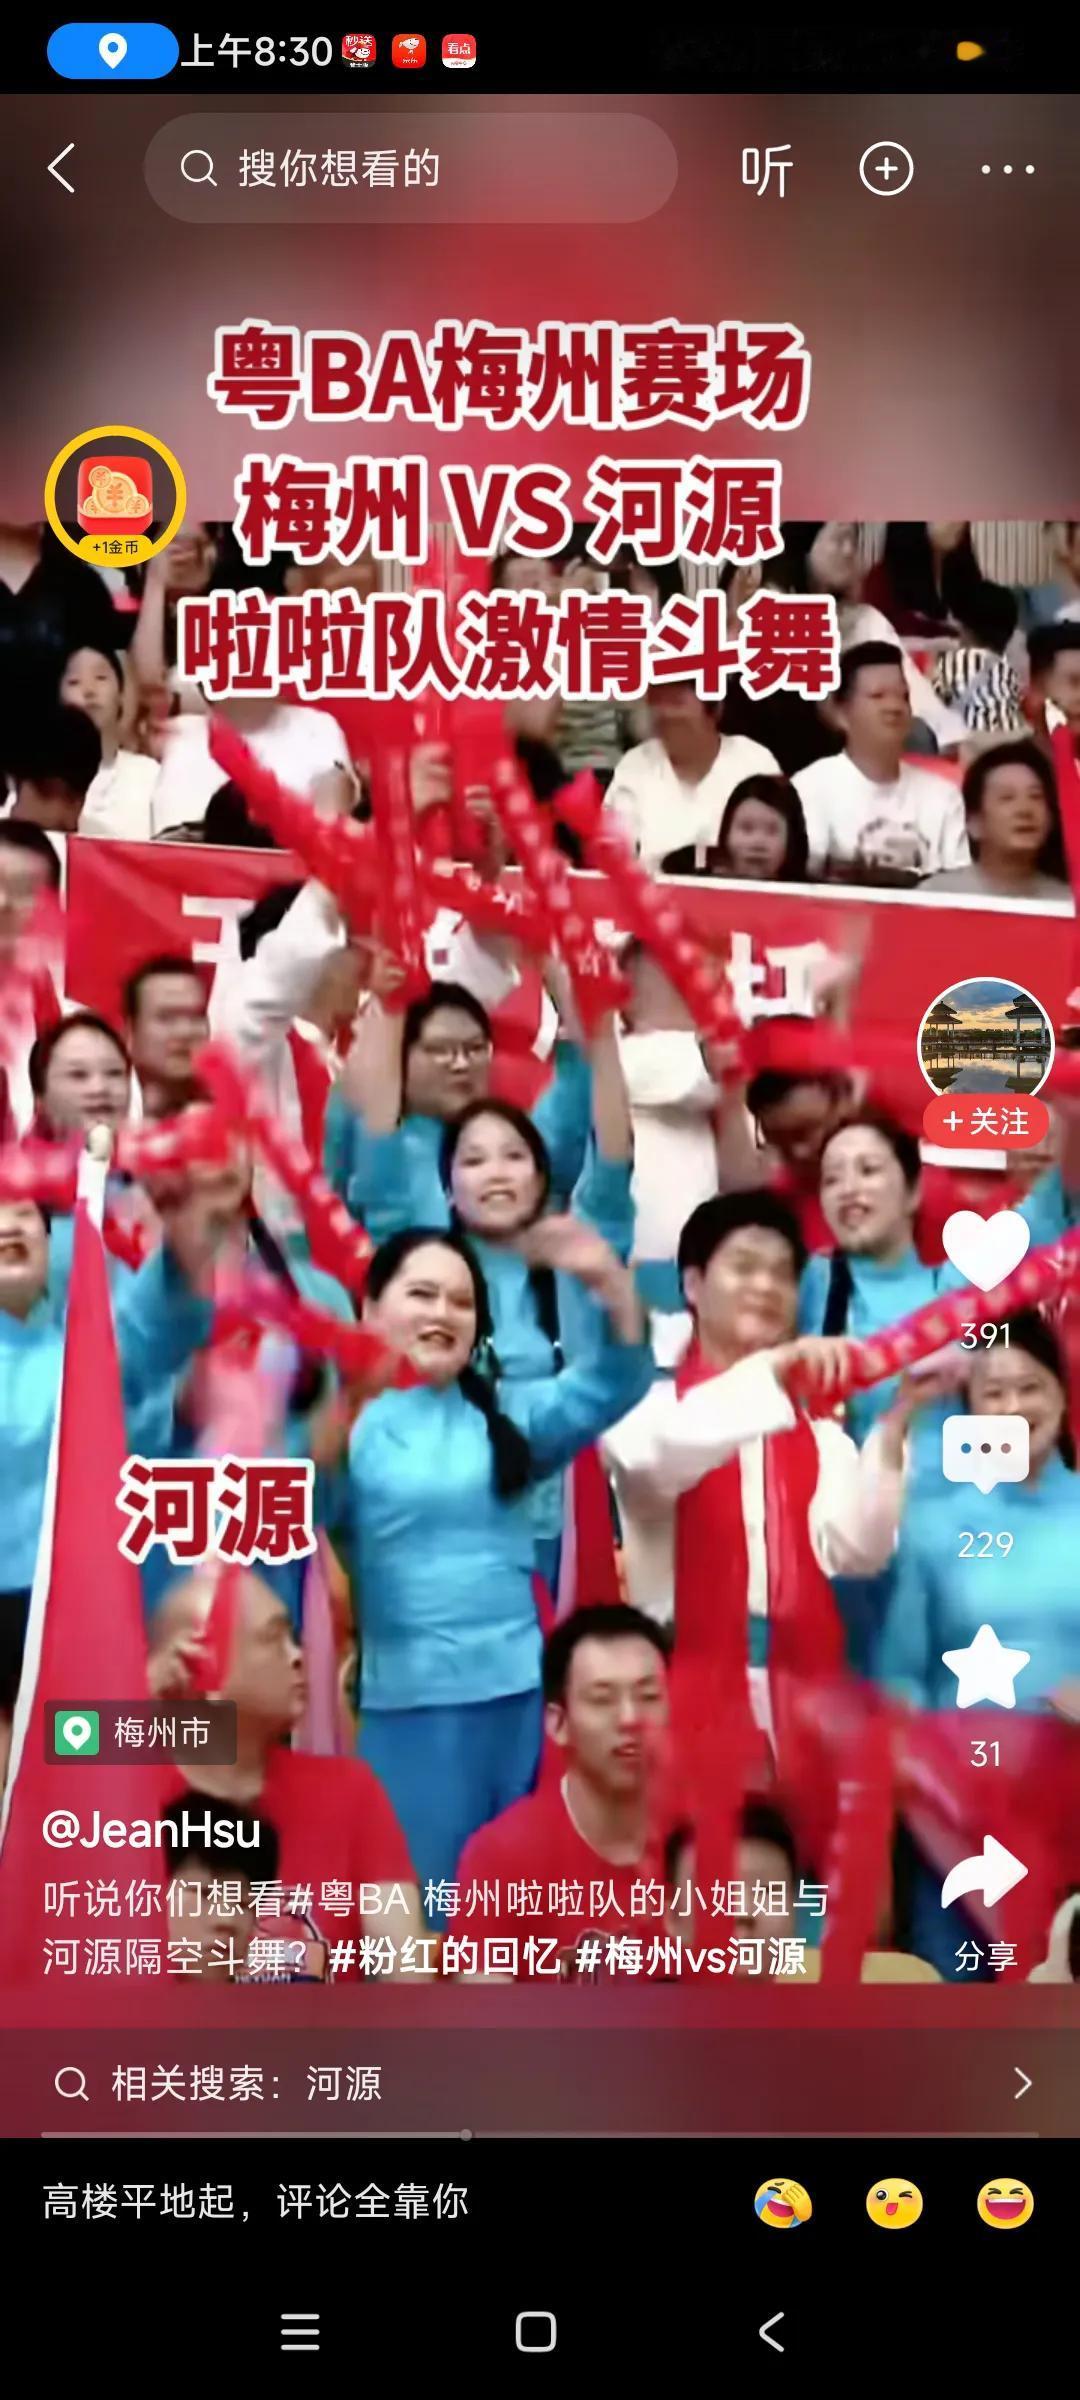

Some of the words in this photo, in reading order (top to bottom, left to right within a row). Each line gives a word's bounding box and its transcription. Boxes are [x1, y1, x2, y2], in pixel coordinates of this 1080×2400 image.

[182, 34, 334, 69] 上午8:30
[447, 42, 471, 55] 看点
[239, 148, 441, 189] 搜你想看的
[742, 145, 794, 199] 听
[93, 540, 138, 555] +1金币
[960, 1323, 1011, 1350] 391
[958, 1532, 1014, 1559] 229
[114, 1716, 210, 1749] 梅州市
[970, 1741, 1001, 1768] 31
[43, 1810, 261, 1849] @JeanHsu
[44, 1879, 411, 1919] 听说你们想看#粤BA
[424, 1879, 829, 1918] 梅州啦啦队的小姐姐与
[329, 1936, 561, 1976] #粉红的回忆
[576, 1936, 807, 1976] #梅州vs河源
[954, 1941, 1018, 1973] 分享
[42, 2182, 469, 2223] 高楼平地起，评论全靠你
